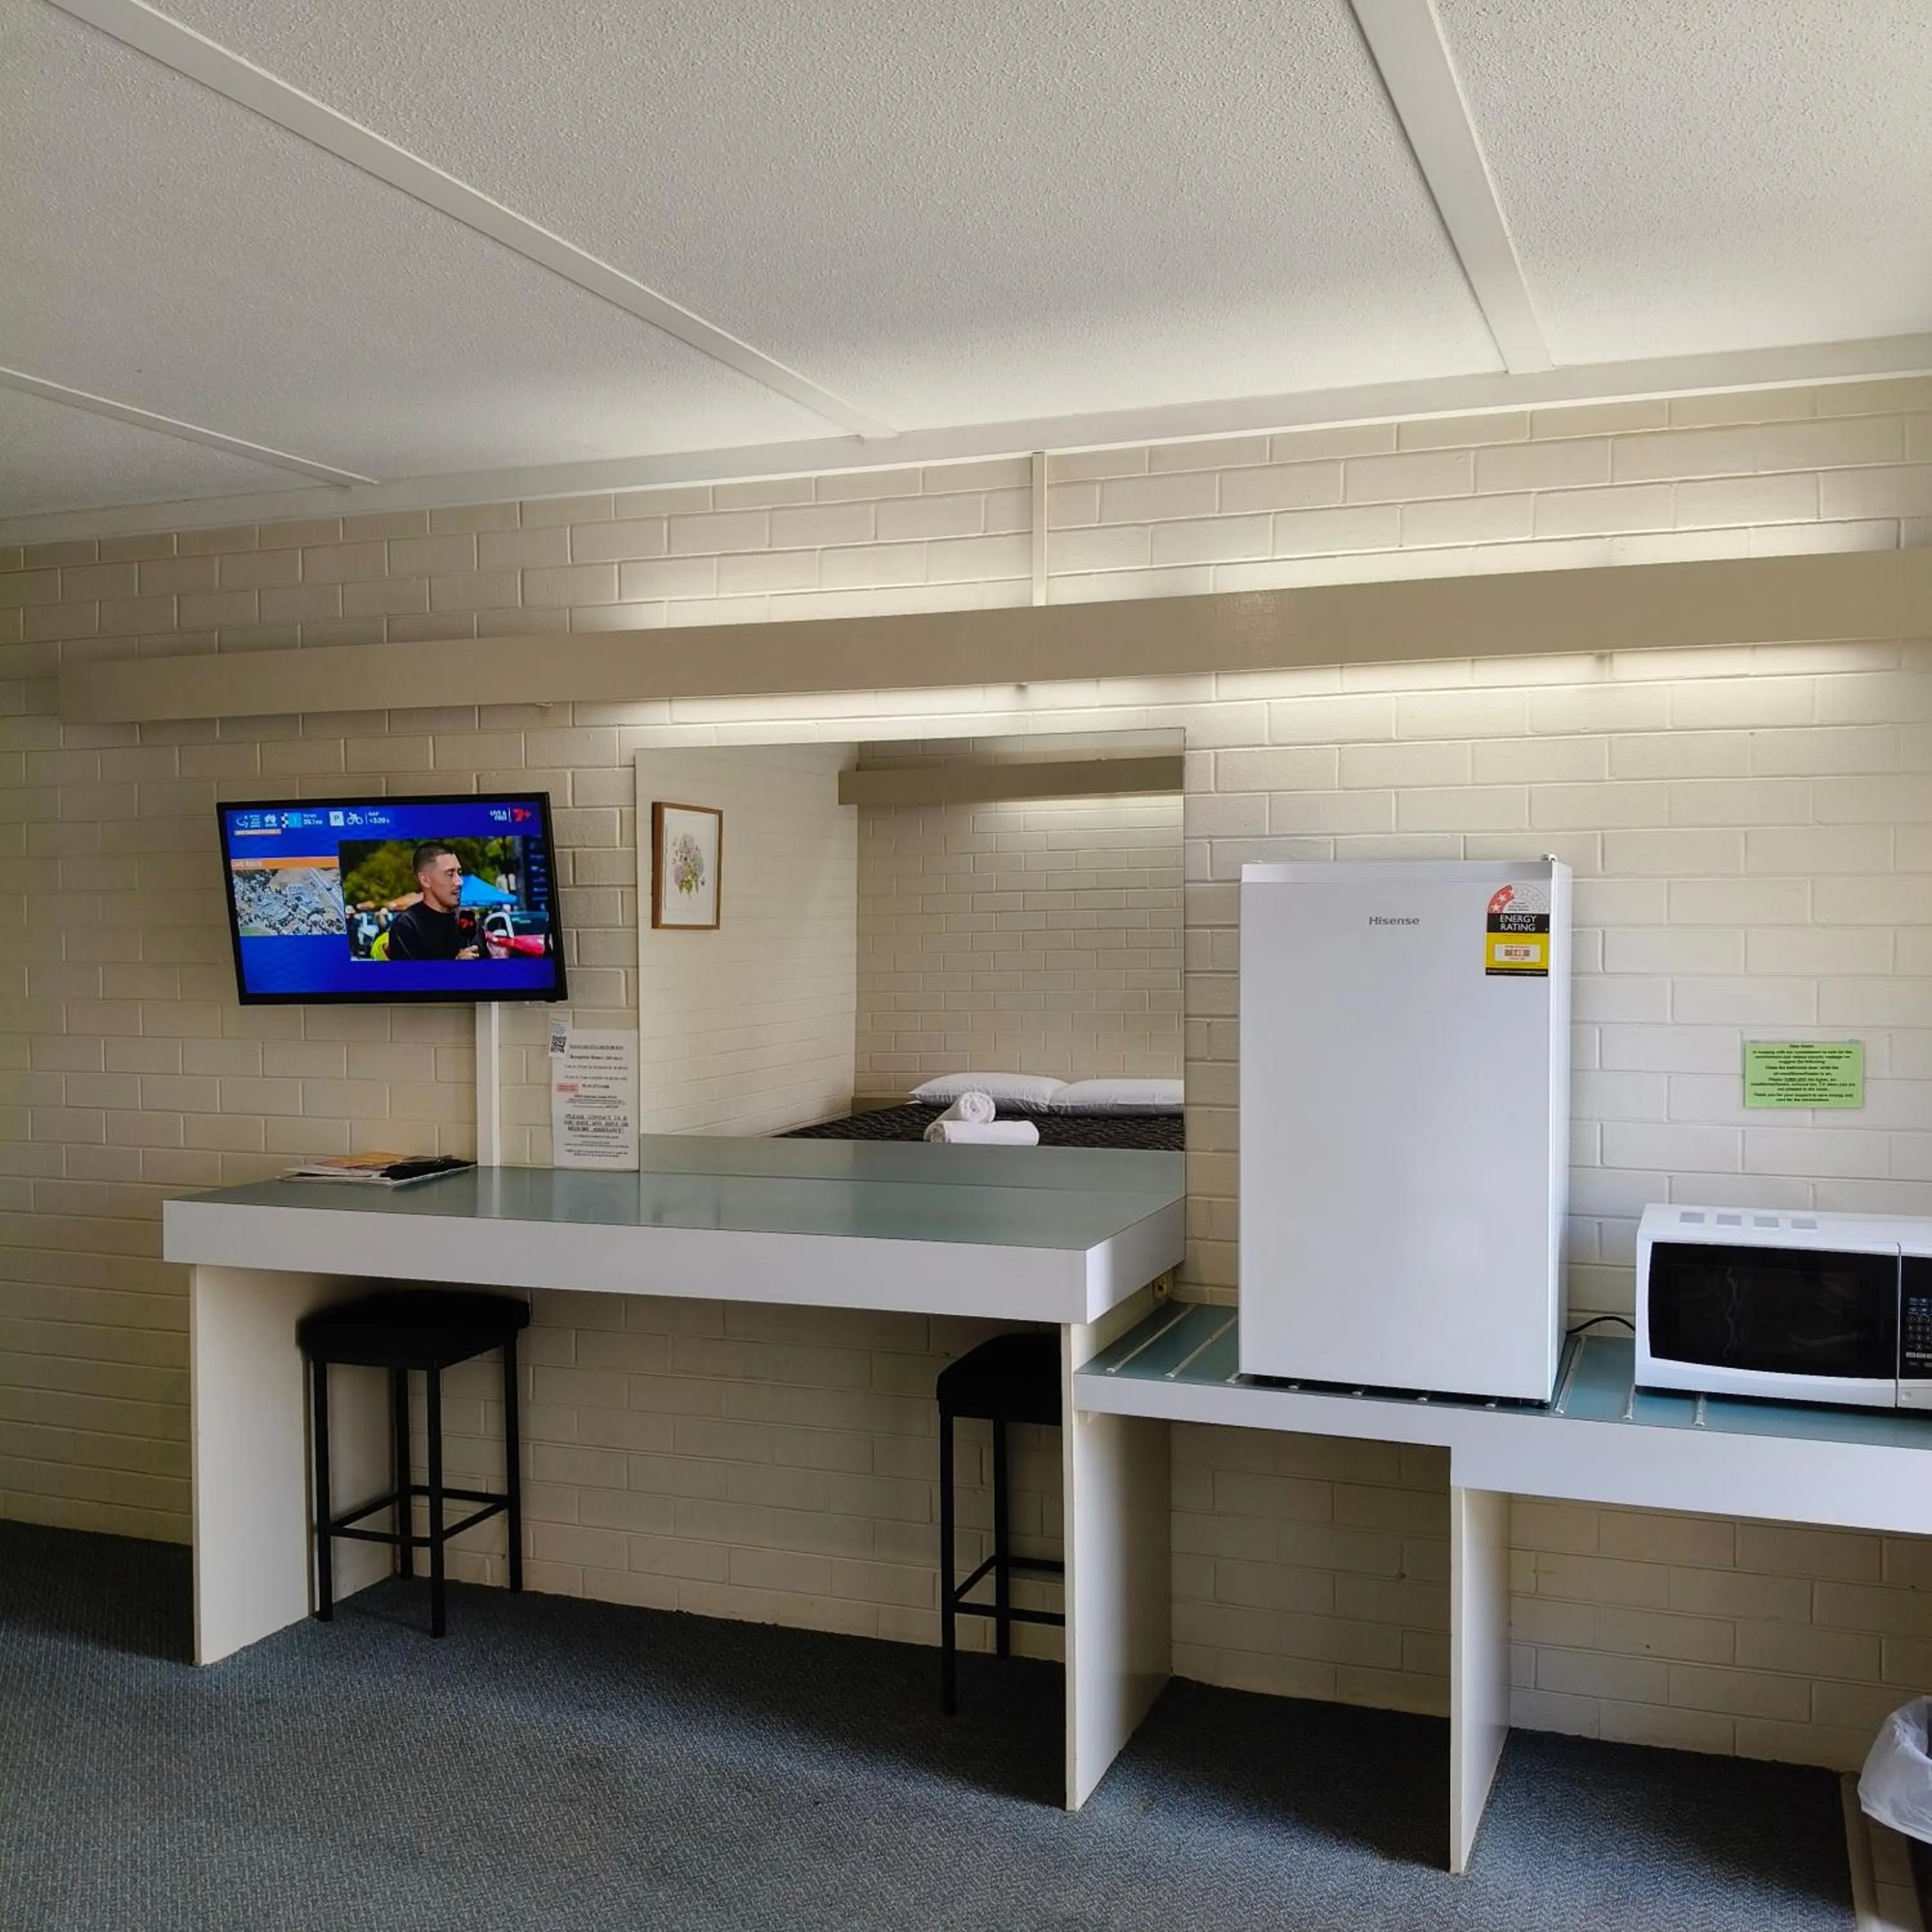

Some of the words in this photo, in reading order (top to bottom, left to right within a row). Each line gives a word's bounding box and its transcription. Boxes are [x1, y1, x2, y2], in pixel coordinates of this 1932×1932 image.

[1368, 916, 1420, 925] Hisense
[1499, 914, 1537, 923] ENERGY
[1499, 923, 1537, 932] RATING
